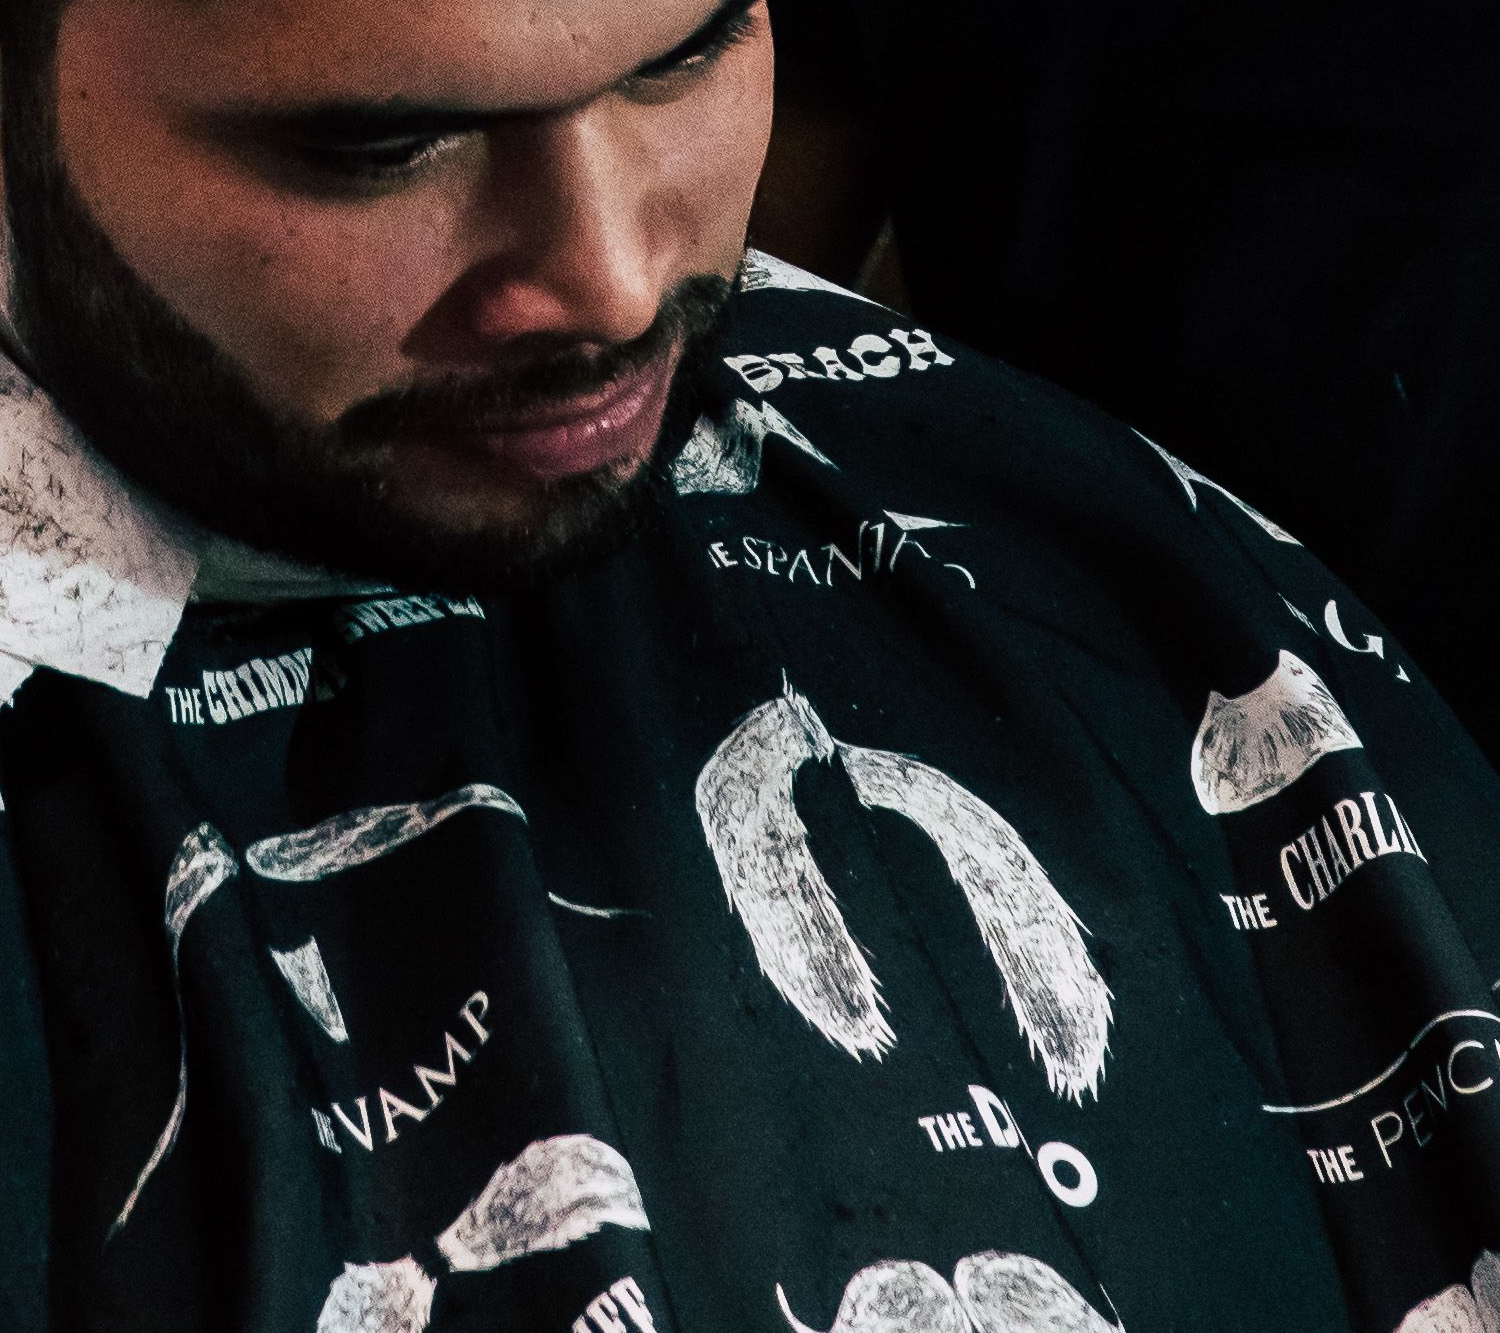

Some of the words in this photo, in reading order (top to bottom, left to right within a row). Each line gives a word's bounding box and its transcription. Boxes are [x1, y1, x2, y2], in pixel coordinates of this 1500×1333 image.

[723, 329, 955, 393] BEACH
[165, 687, 204, 725] THE
[1219, 893, 1278, 930] THE
[332, 990, 490, 1151] VAMP
[919, 1112, 983, 1153] THE
[968, 1085, 1098, 1208] DO
[1307, 1145, 1364, 1183] THE
